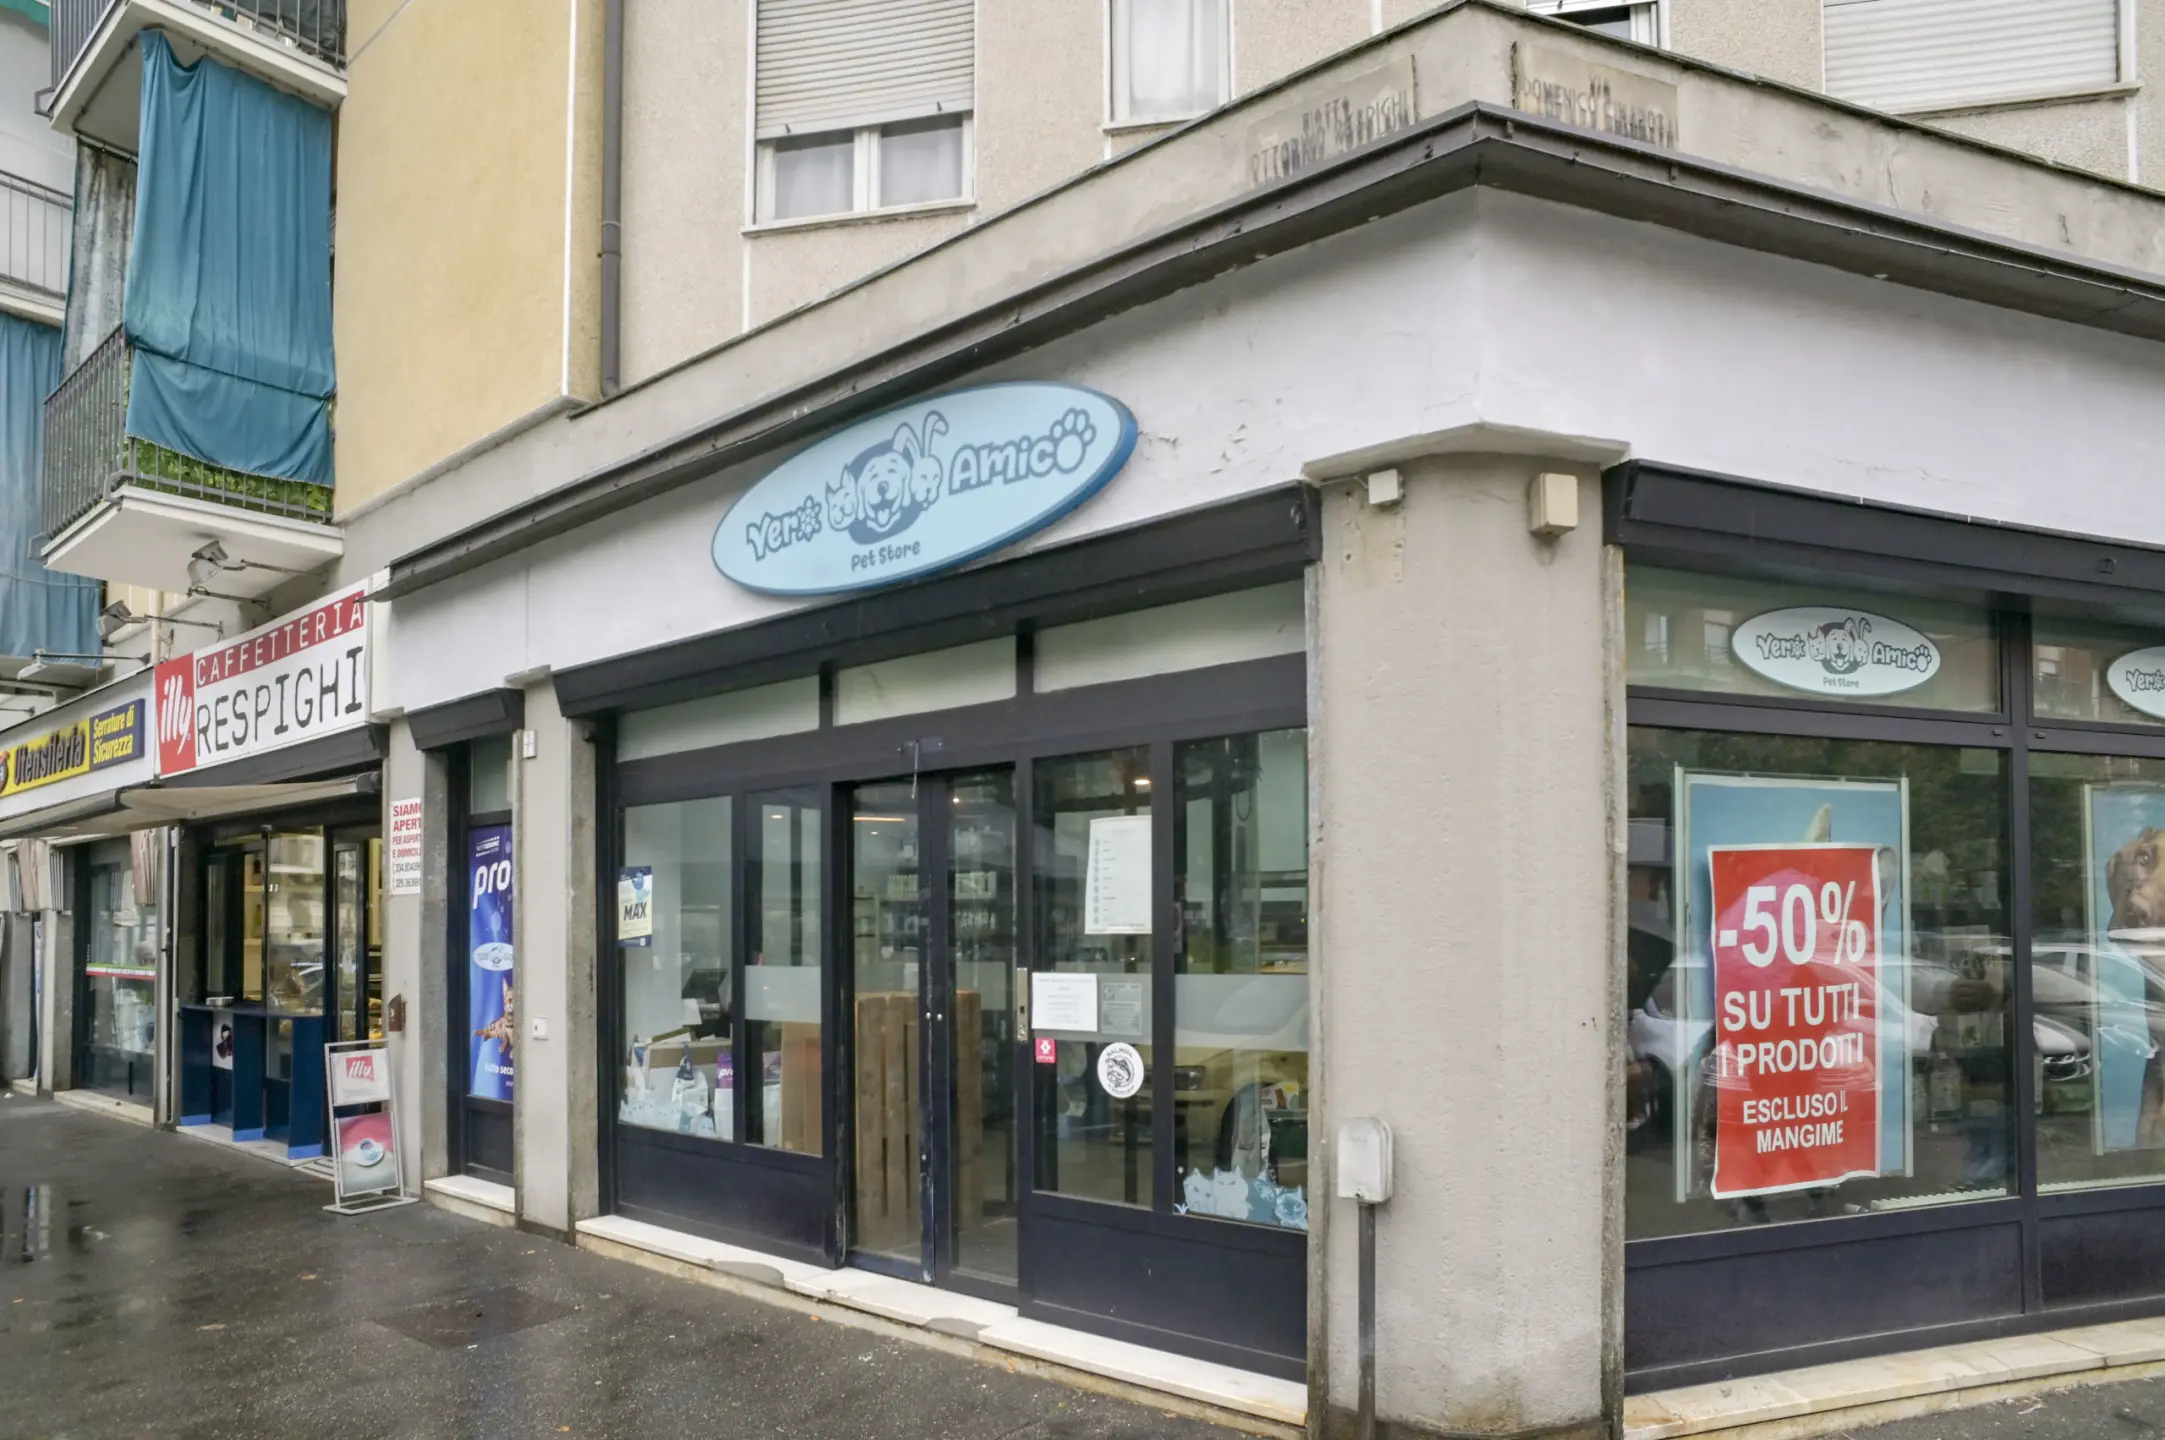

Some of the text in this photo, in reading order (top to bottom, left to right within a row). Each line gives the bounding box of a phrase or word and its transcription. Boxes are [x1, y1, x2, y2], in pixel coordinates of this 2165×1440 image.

[948, 407, 1098, 496] Amico
[850, 540, 922, 573] Pet Store
[197, 597, 363, 686] CAFFETTERIA
[1871, 641, 1932, 673] Amico
[196, 645, 364, 757] RESPIGHI
[1822, 677, 1860, 689] Pet Store
[93, 704, 135, 739] Serrature di
[160, 674, 193, 755] illy
[14, 722, 86, 786] Utensileria
[93, 733, 133, 764] Sicurezza
[473, 859, 512, 910] pro
[623, 901, 648, 921] MAX
[1718, 880, 1867, 967] -50%
[1723, 982, 1860, 1032] SU TUTTI
[349, 1060, 372, 1078] illy
[1737, 1032, 1864, 1076] PRODOTTI
[1743, 1092, 1837, 1124] ESCLUSO
[1756, 1120, 1844, 1154] MANGIME
